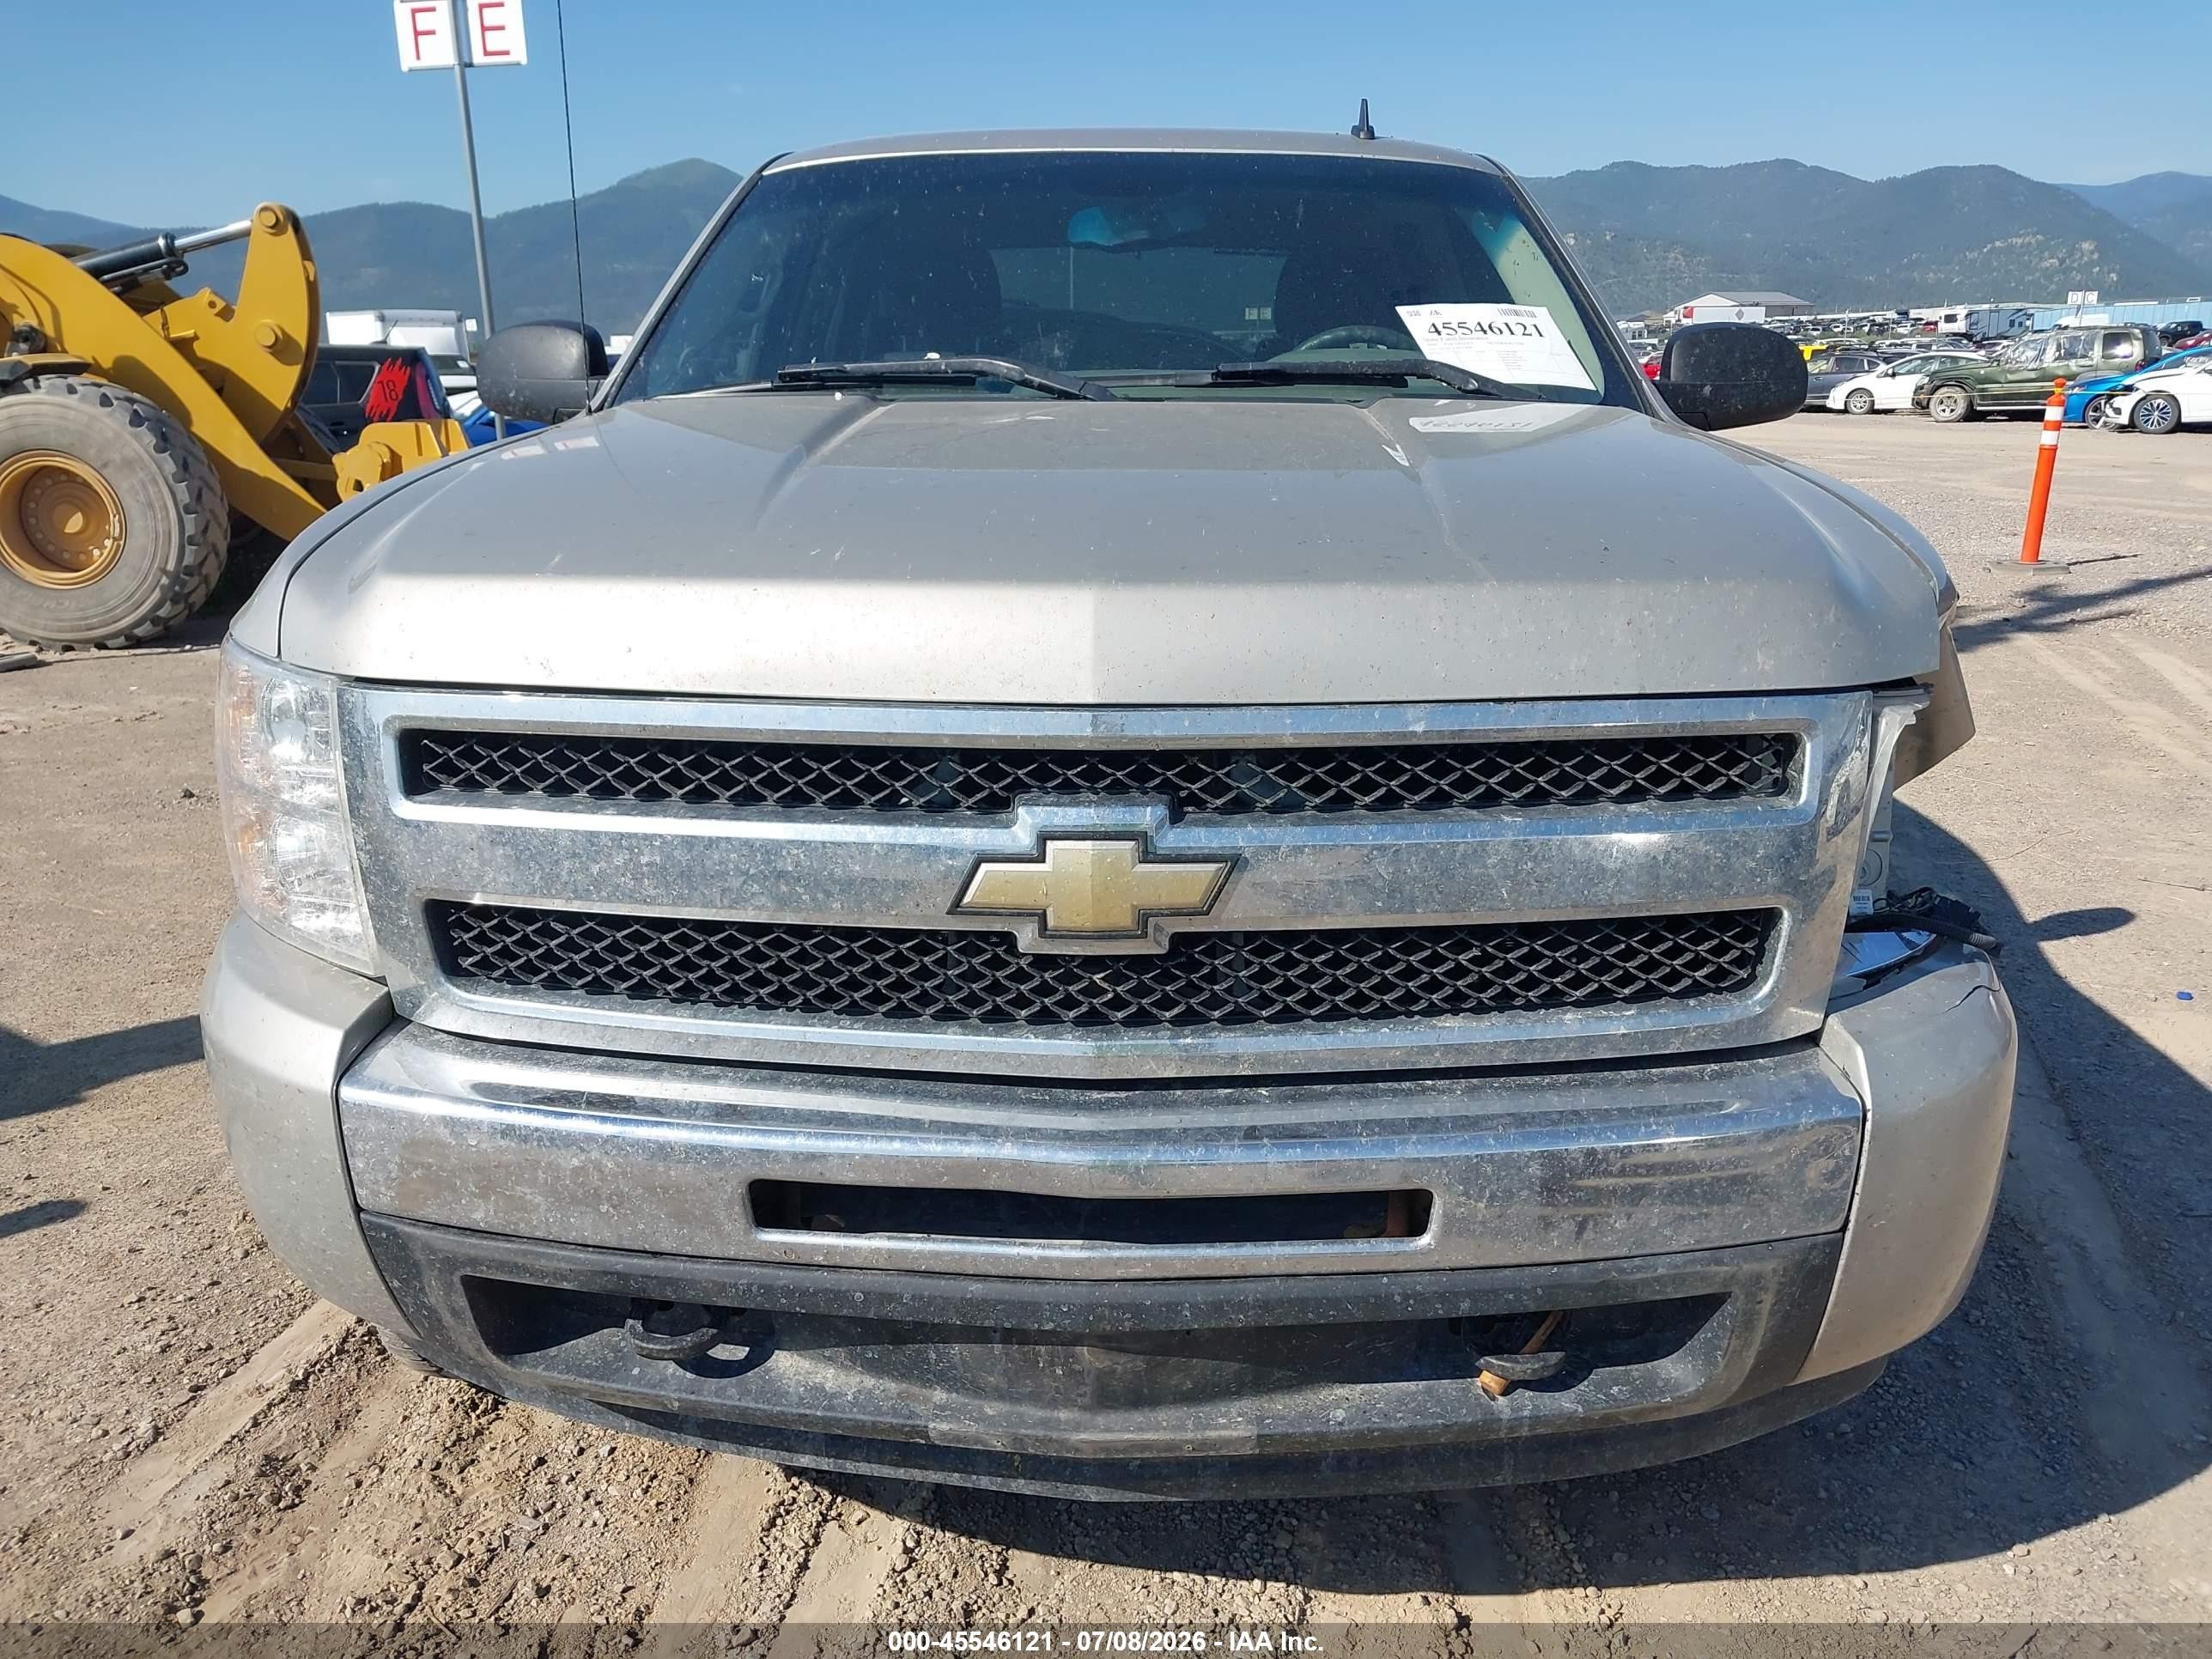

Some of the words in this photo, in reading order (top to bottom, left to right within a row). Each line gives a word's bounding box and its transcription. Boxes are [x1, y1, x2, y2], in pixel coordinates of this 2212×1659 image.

[410, 6, 437, 61] F
[477, 2, 511, 57] E
[2070, 293, 2079, 303] D
[2087, 292, 2095, 304] C
[1428, 320, 1546, 338] 45546121
